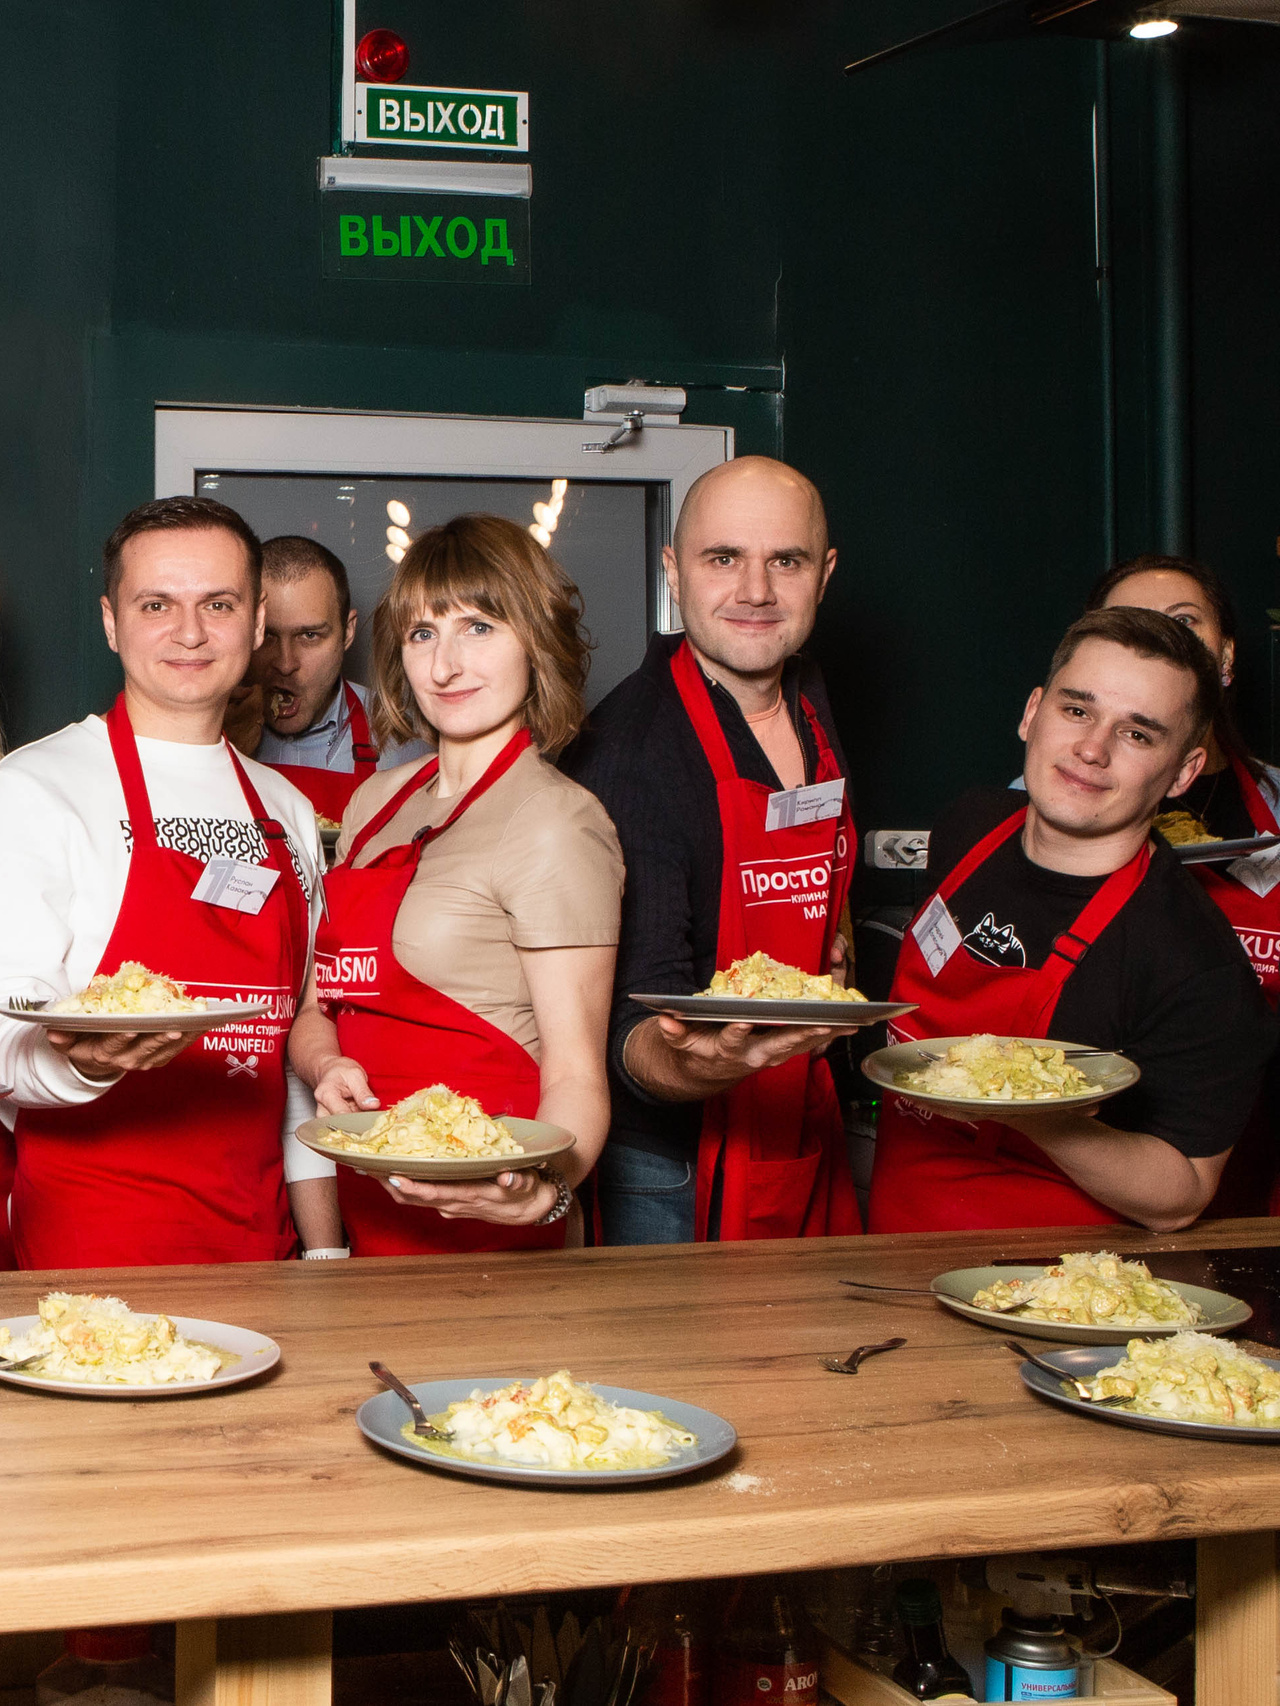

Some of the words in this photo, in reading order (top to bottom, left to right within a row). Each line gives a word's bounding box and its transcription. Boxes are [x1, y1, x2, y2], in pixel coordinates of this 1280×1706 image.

[379, 98, 505, 140] ВЫХОД
[340, 214, 514, 266] ВЫХОД
[203, 1036, 275, 1053] MAUNFELD
